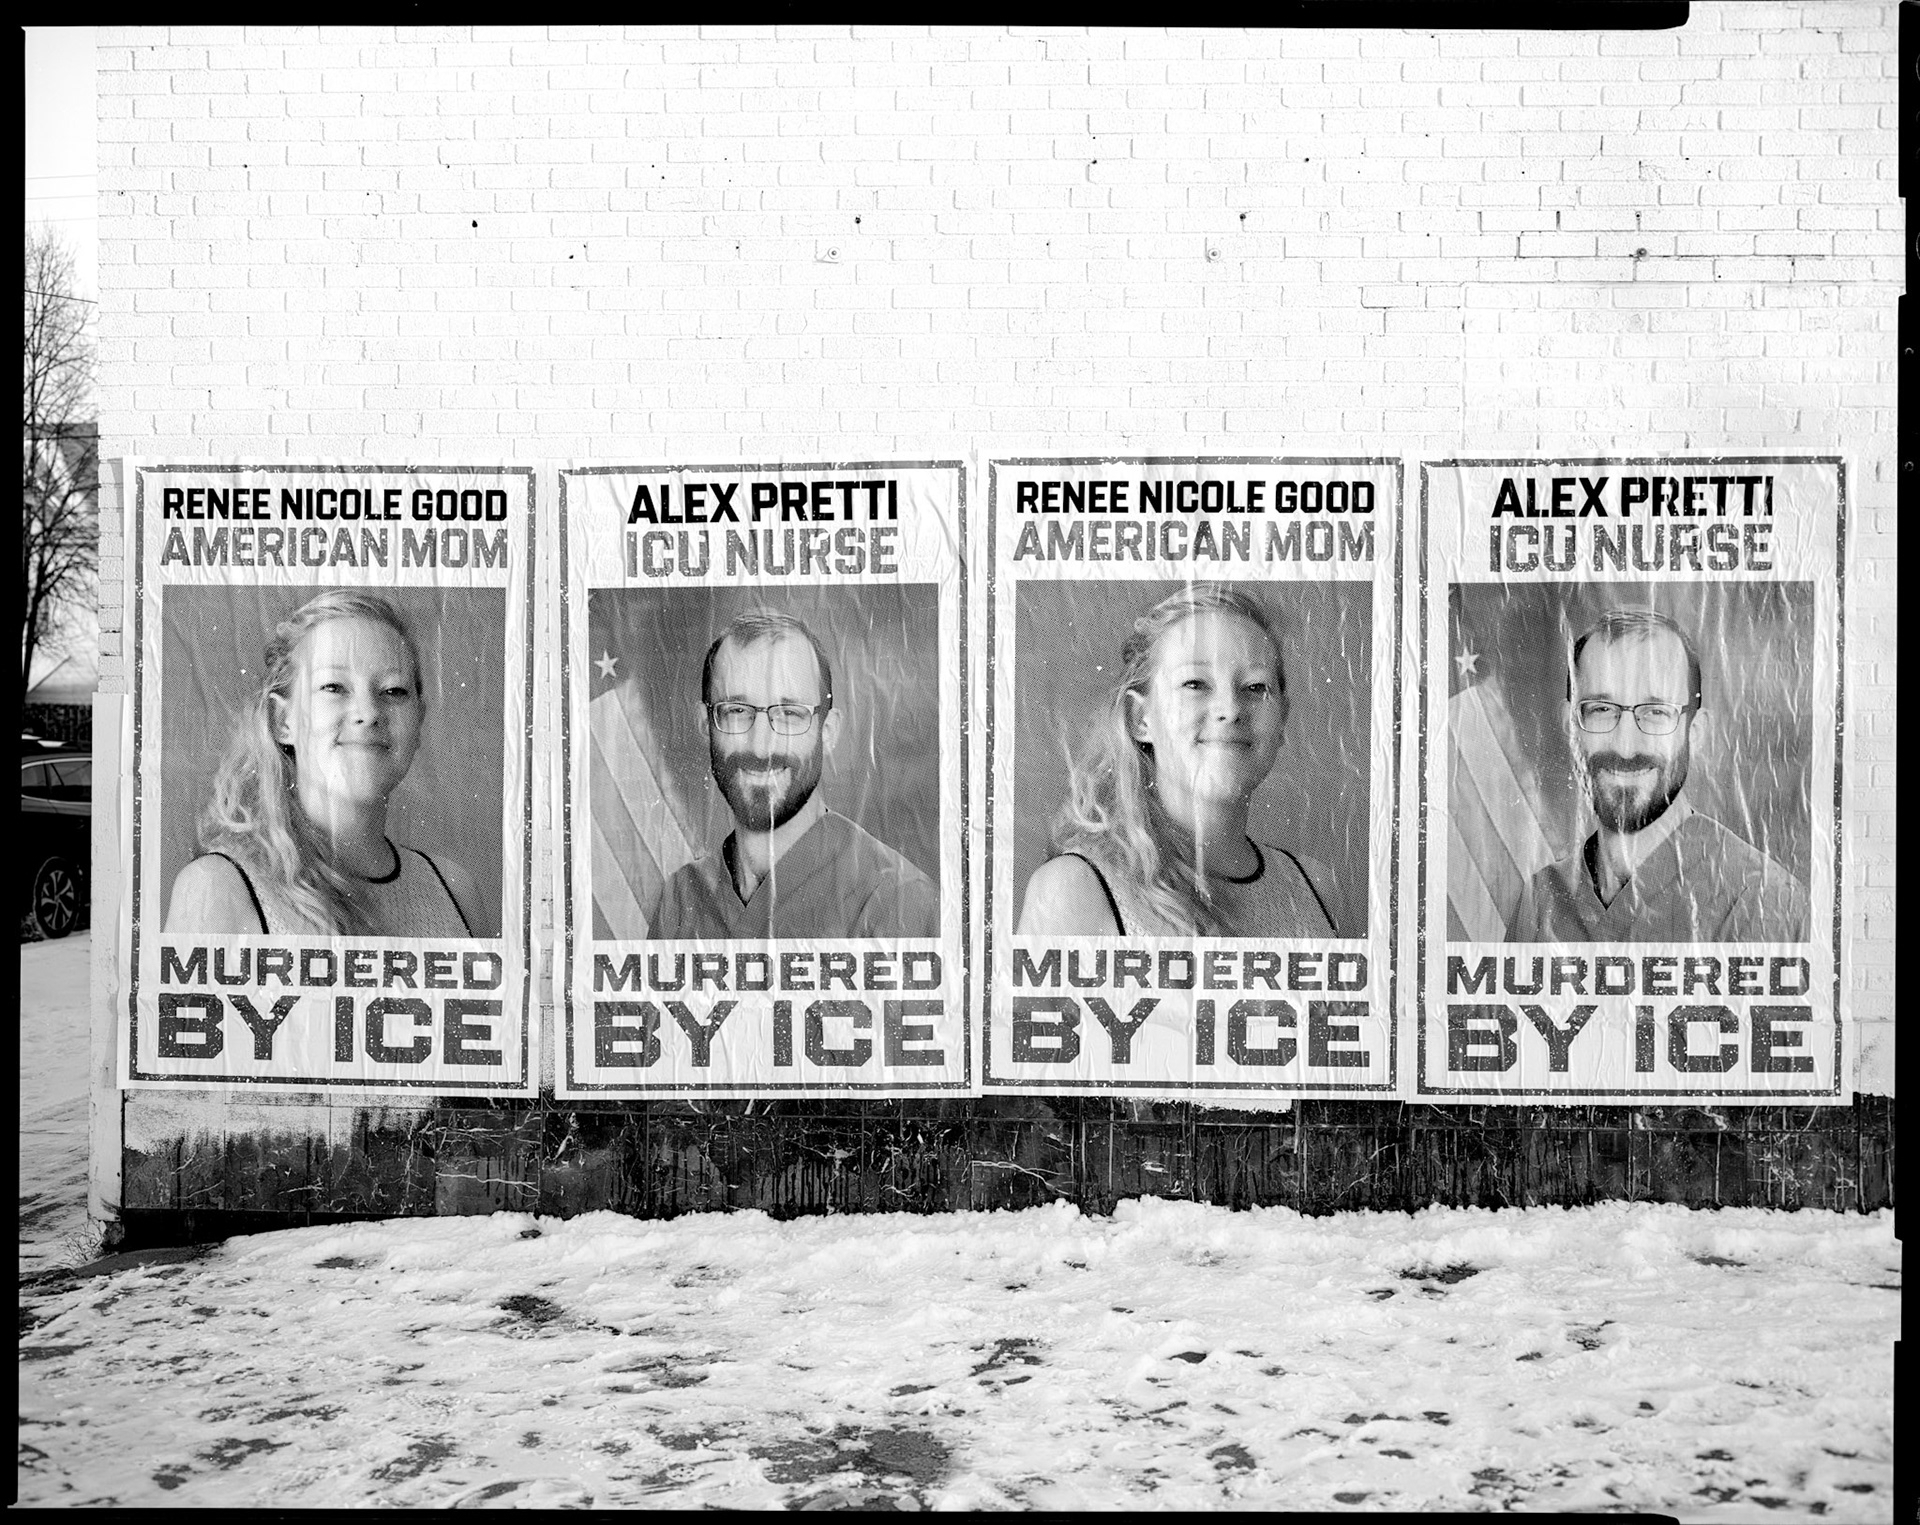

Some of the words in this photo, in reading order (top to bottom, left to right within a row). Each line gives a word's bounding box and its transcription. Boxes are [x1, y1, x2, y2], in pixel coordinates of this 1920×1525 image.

[163, 488, 270, 519] RENEE
[281, 488, 401, 520] NICOLE
[412, 488, 508, 520] GOOD
[627, 483, 739, 524] ALEX
[751, 480, 898, 521] PRETTI
[1016, 481, 1128, 512] RENEE
[1139, 481, 1265, 512] NICOLE
[1276, 481, 1375, 513] GOOD
[1491, 476, 1608, 518] ALEX
[1621, 474, 1773, 517] PRETTI
[160, 526, 388, 567] AMERICAN
[402, 527, 508, 569] MOM
[626, 530, 710, 577] ICU
[727, 527, 899, 575] NURSE
[1014, 521, 1251, 561] AMERICAN
[1266, 521, 1375, 561] MOM
[1489, 525, 1576, 572] ICU
[1592, 523, 1773, 572] NURSE
[160, 947, 502, 989] MURDERED
[594, 952, 942, 992] MURDERED
[1012, 949, 1367, 991] MURDERED
[1447, 956, 1809, 996] MURDERED
[158, 994, 298, 1060] BY
[335, 997, 503, 1065] ICE
[594, 1000, 739, 1068] BY
[773, 999, 944, 1066] ICE
[1011, 997, 1160, 1065] BY
[1196, 1000, 1370, 1068] ICE
[1448, 1004, 1597, 1072] BY
[1634, 1005, 1813, 1073] ICE
